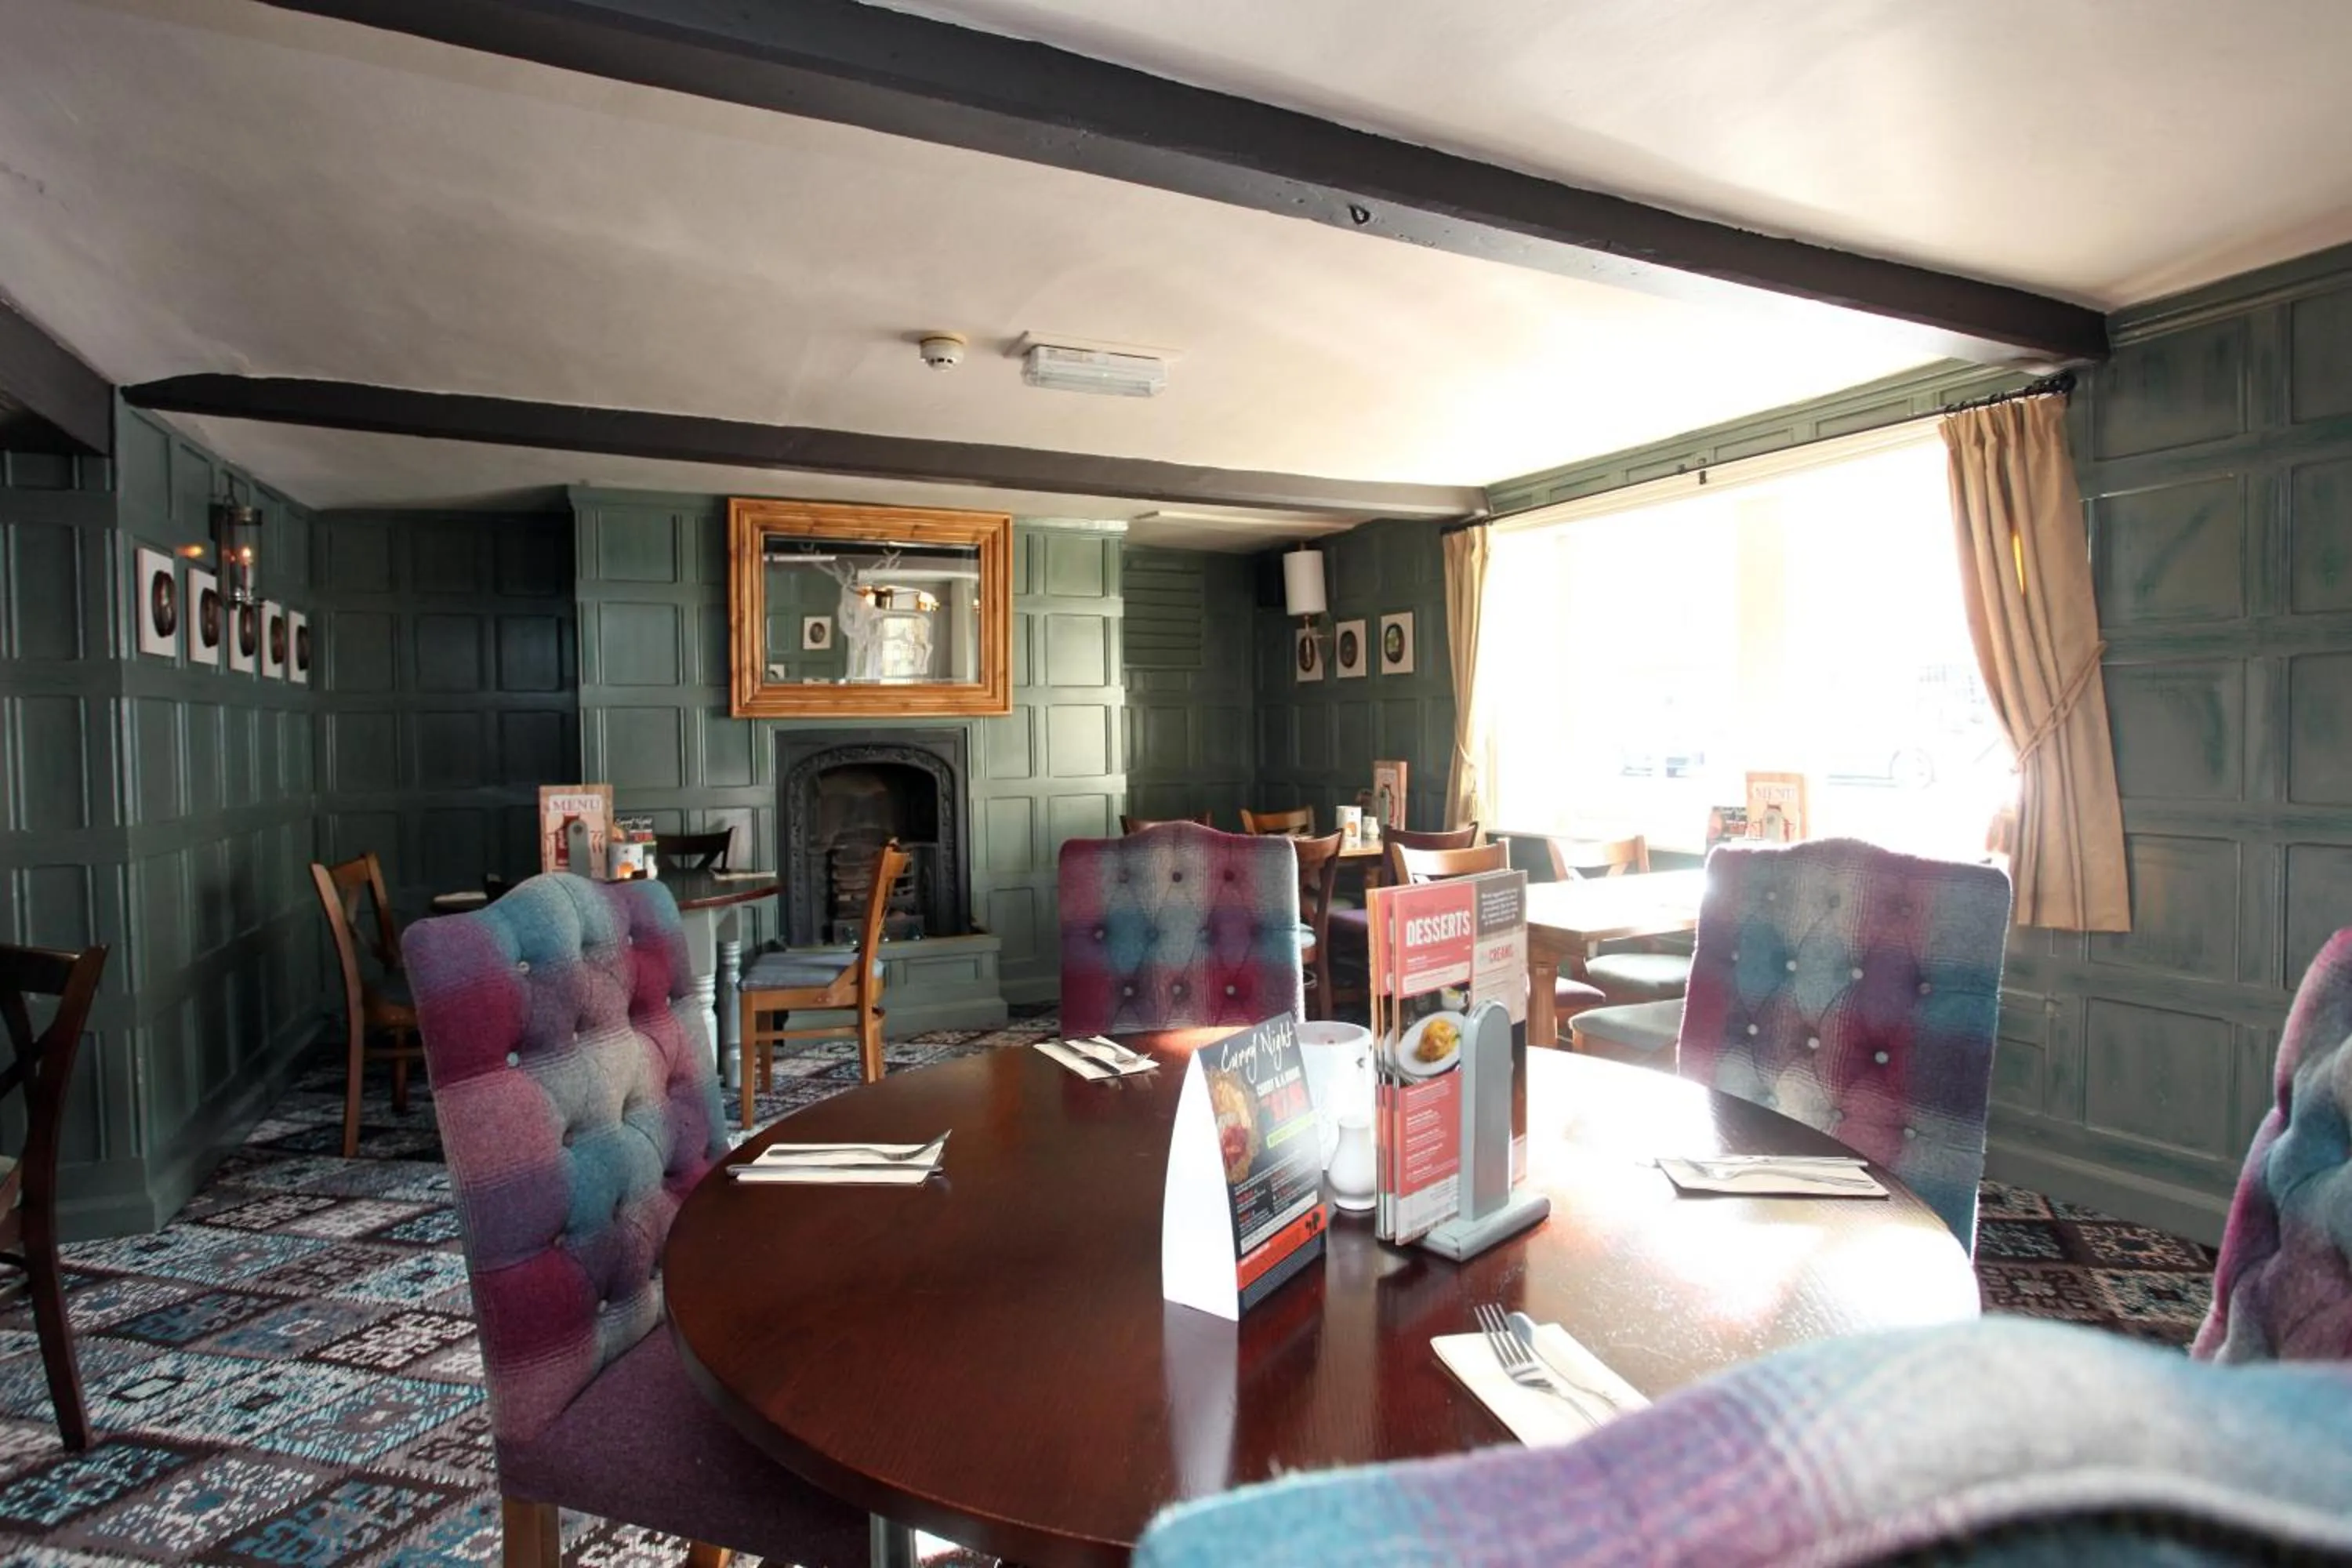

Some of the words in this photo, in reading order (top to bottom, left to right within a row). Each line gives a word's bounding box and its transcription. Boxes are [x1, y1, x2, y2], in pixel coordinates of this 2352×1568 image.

[553, 798, 601, 811] MENU
[1406, 910, 1471, 948] DESSERTS
[1221, 1031, 1258, 1085] Curry
[1259, 1020, 1294, 1072] Night
